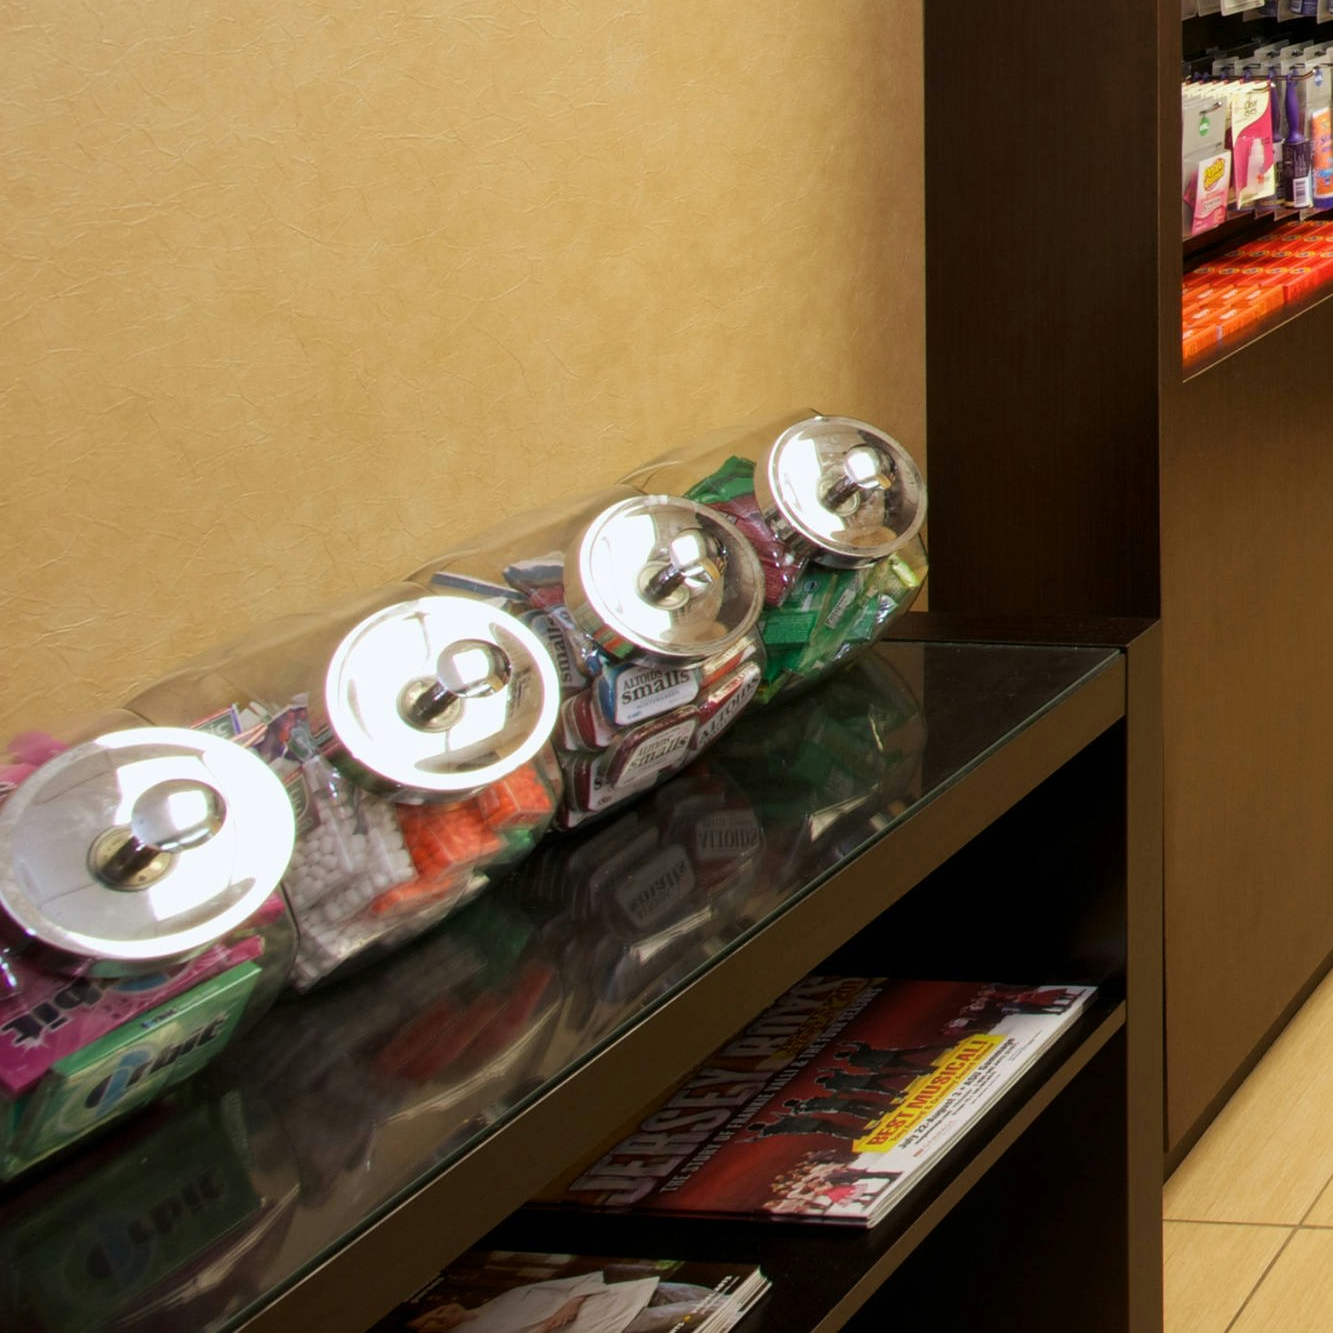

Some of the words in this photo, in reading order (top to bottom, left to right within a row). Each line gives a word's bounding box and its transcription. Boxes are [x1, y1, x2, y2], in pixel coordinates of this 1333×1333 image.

[622, 669, 690, 705] smalls
[624, 669, 662, 689] ALTOIDS
[700, 676, 759, 743] ALTOIDS
[568, 1067, 776, 1205] JERSEY
[720, 977, 870, 1057] BOYS
[679, 1143, 724, 1172] STORY
[710, 1131, 736, 1141] OF
[724, 1092, 777, 1128] FRANKIE
[764, 1068, 801, 1090] VALLI
[866, 1112, 915, 1144] BEST
[904, 1040, 989, 1108] MUSICAL!
[896, 1134, 920, 1148] July
[912, 1098, 957, 1133] 22-August
[961, 1071, 983, 1085] ASU
[976, 1038, 1018, 1070] Gammage
